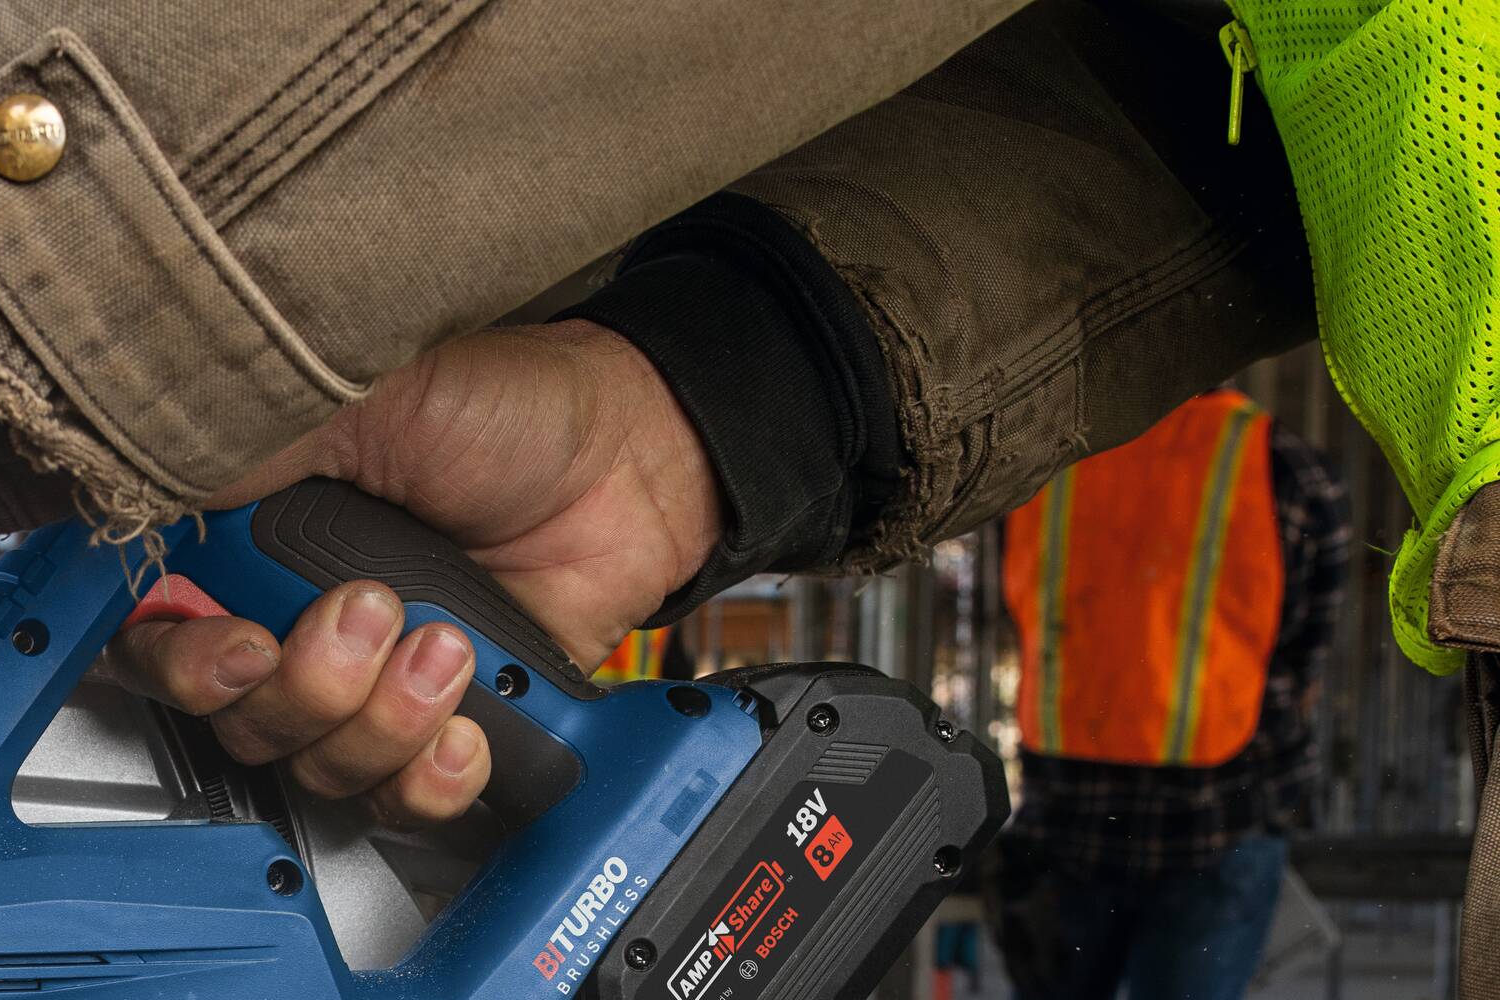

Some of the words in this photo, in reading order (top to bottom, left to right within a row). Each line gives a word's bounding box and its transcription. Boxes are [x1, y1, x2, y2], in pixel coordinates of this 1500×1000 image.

[787, 787, 828, 848] 18V
[532, 856, 628, 981] BITURBO
[556, 875, 648, 995] BRUSHLESS
[679, 950, 713, 999] AMP
[728, 877, 774, 932] Share
[722, 987, 733, 1000] by
[755, 906, 799, 960] BOSCH
